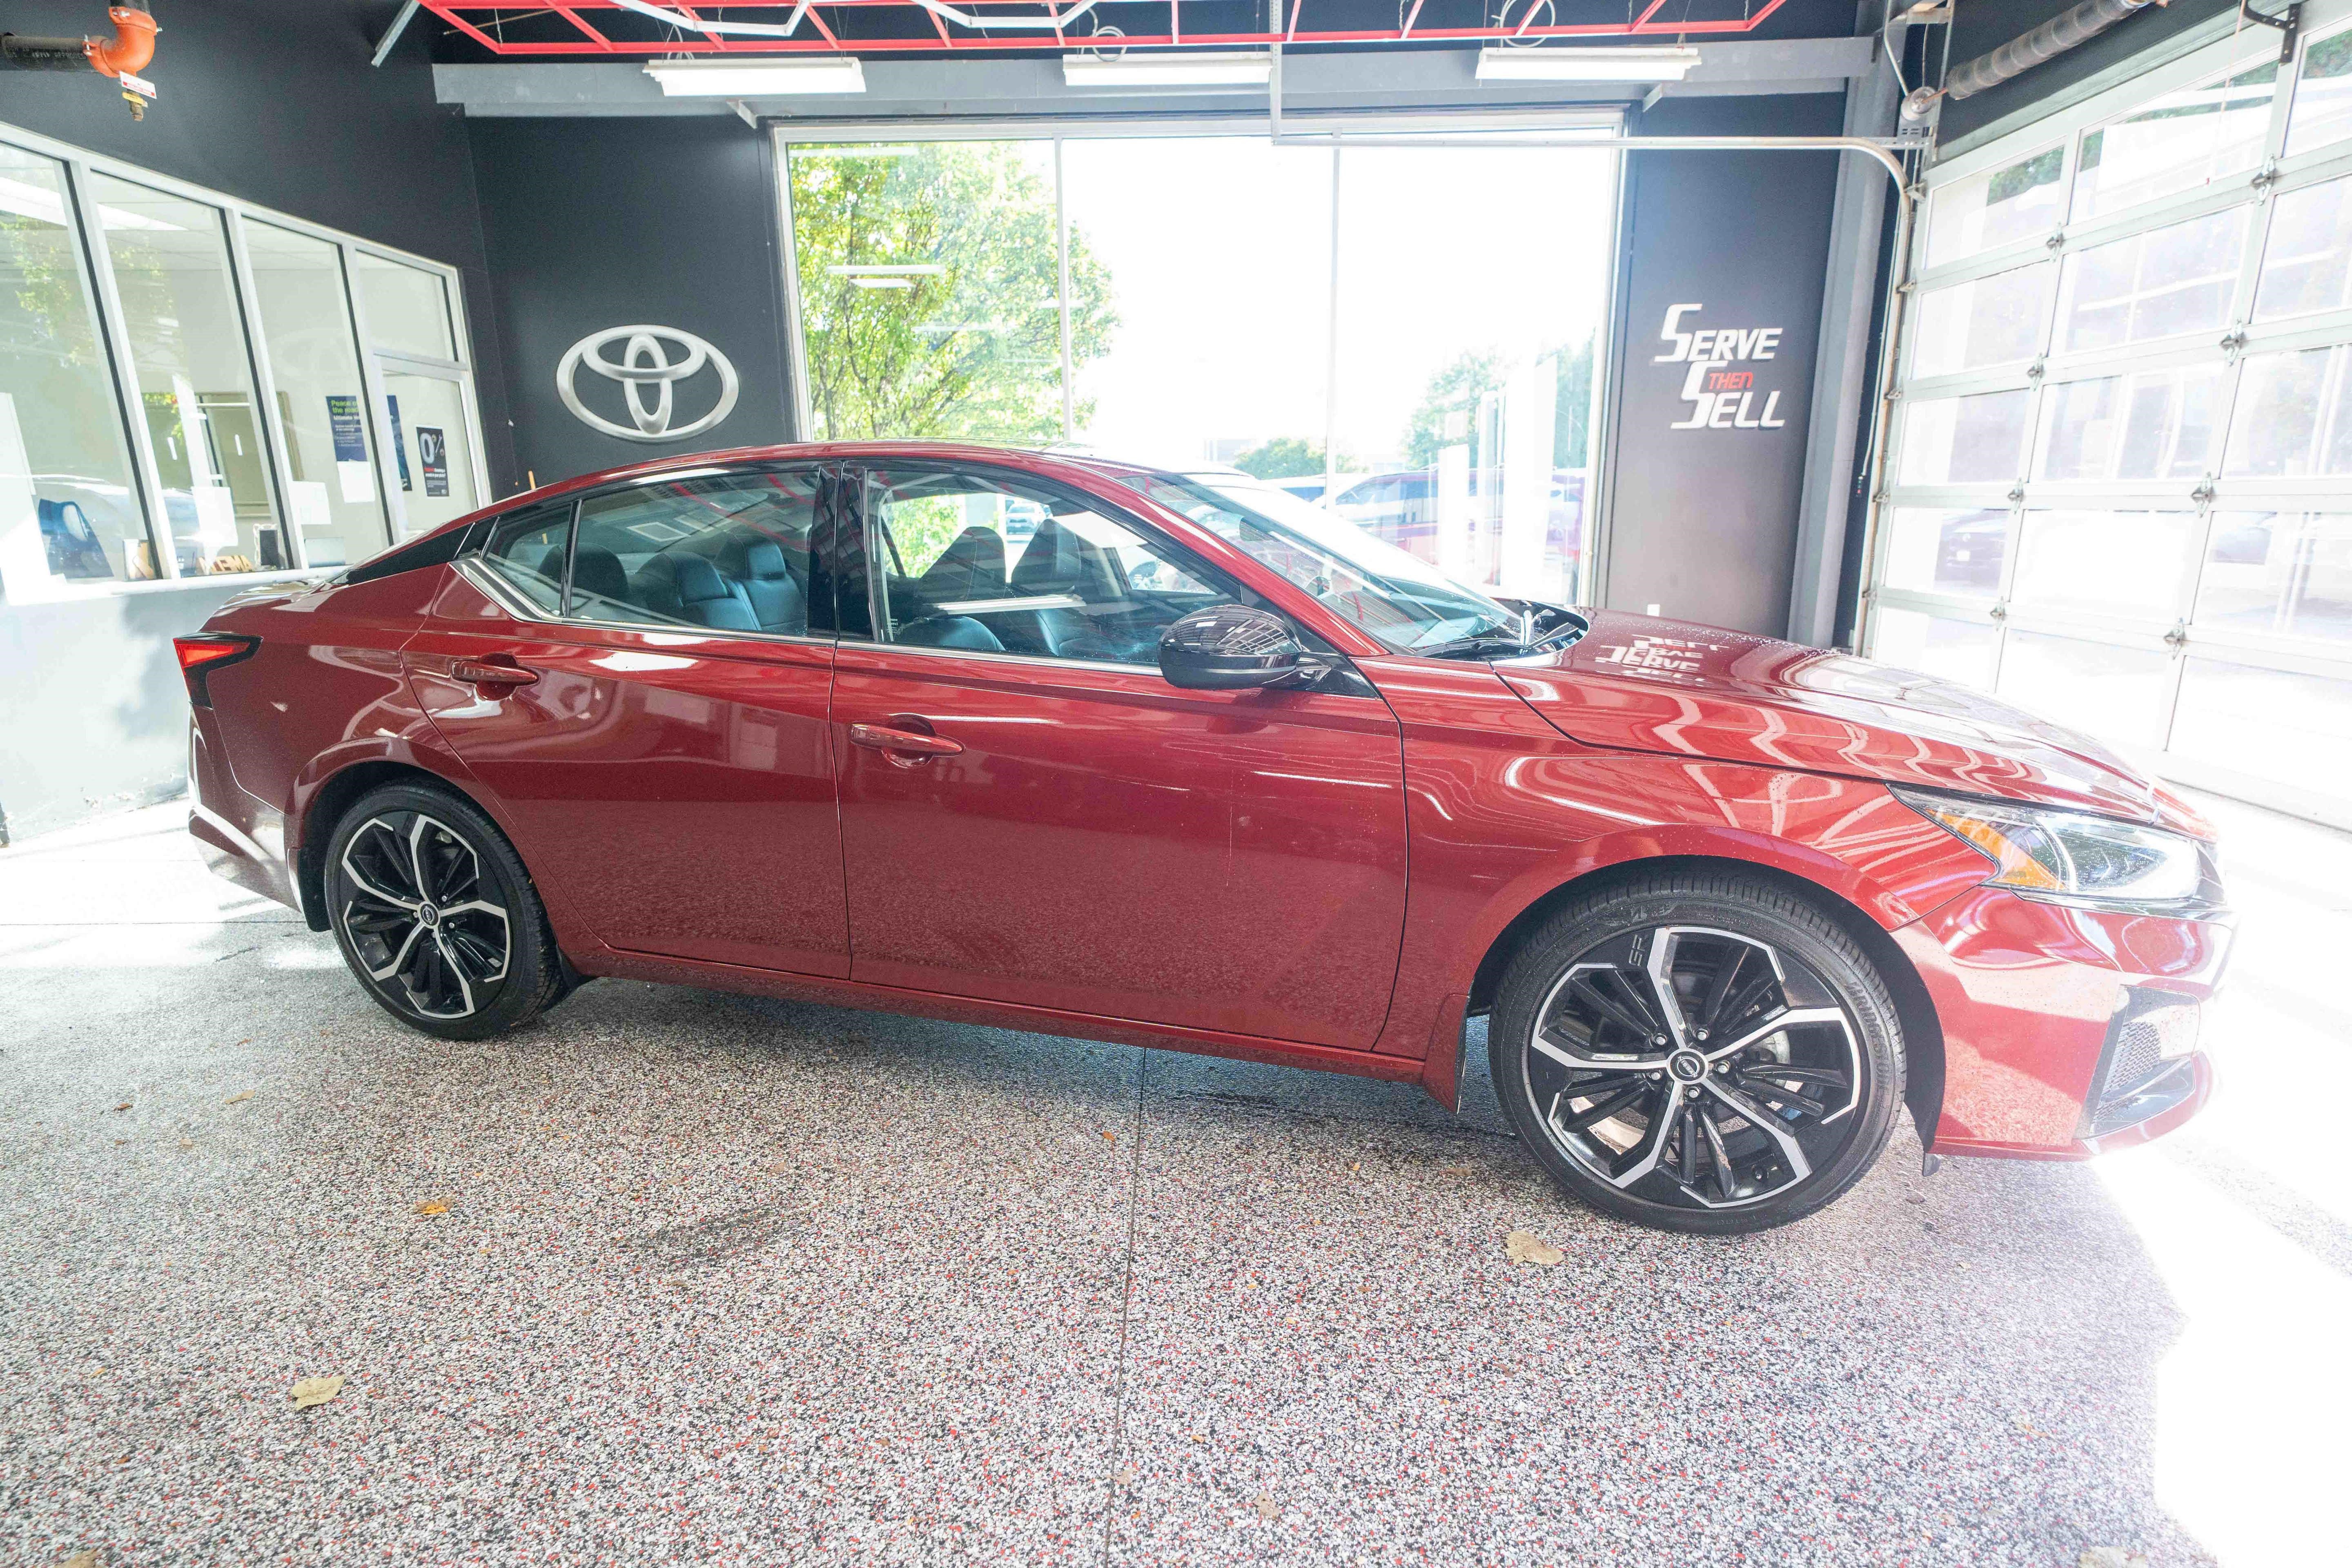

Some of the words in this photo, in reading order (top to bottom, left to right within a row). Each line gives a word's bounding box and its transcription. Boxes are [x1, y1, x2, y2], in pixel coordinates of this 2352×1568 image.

[1654, 303, 1783, 362] SERVE
[1670, 360, 1785, 430] SELL
[1708, 371, 1753, 390] THEN
[1677, 1056, 1698, 1078] NISSAN
